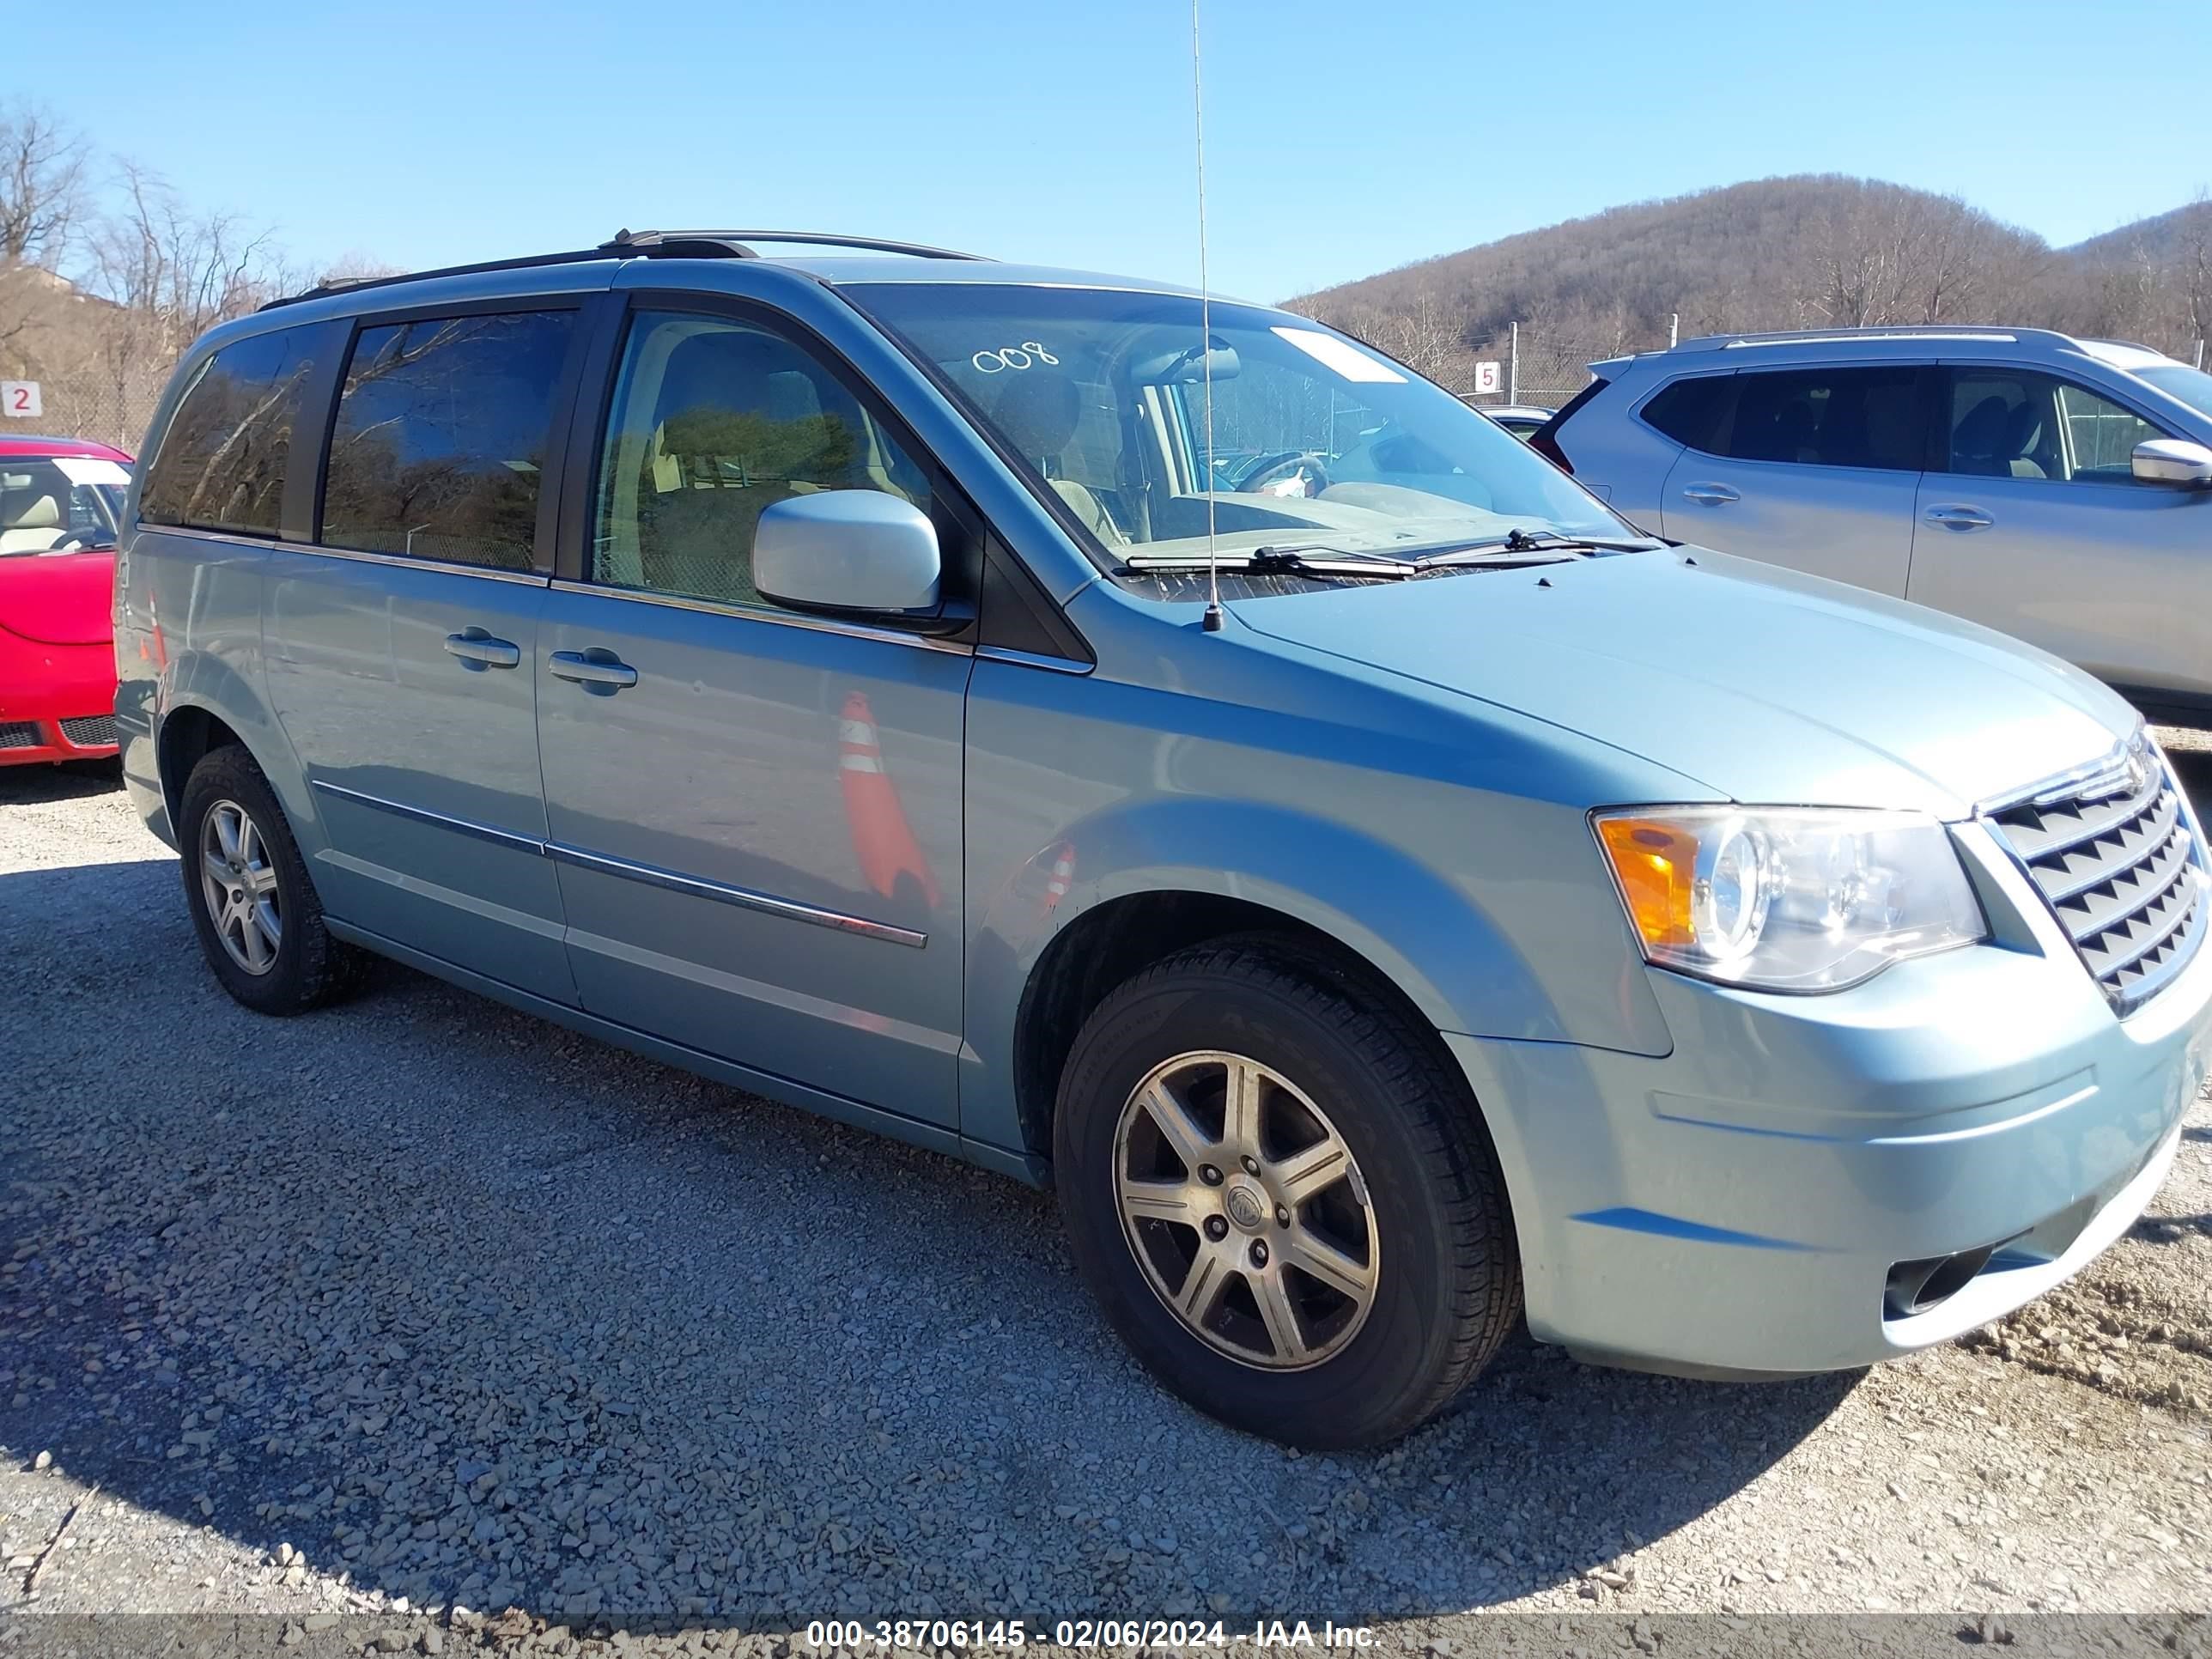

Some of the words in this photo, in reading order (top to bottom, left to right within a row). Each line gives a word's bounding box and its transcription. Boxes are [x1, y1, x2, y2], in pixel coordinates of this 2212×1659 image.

[972, 342, 1060, 373] 008
[1483, 368, 1493, 386] 5
[14, 388, 30, 410] 2
